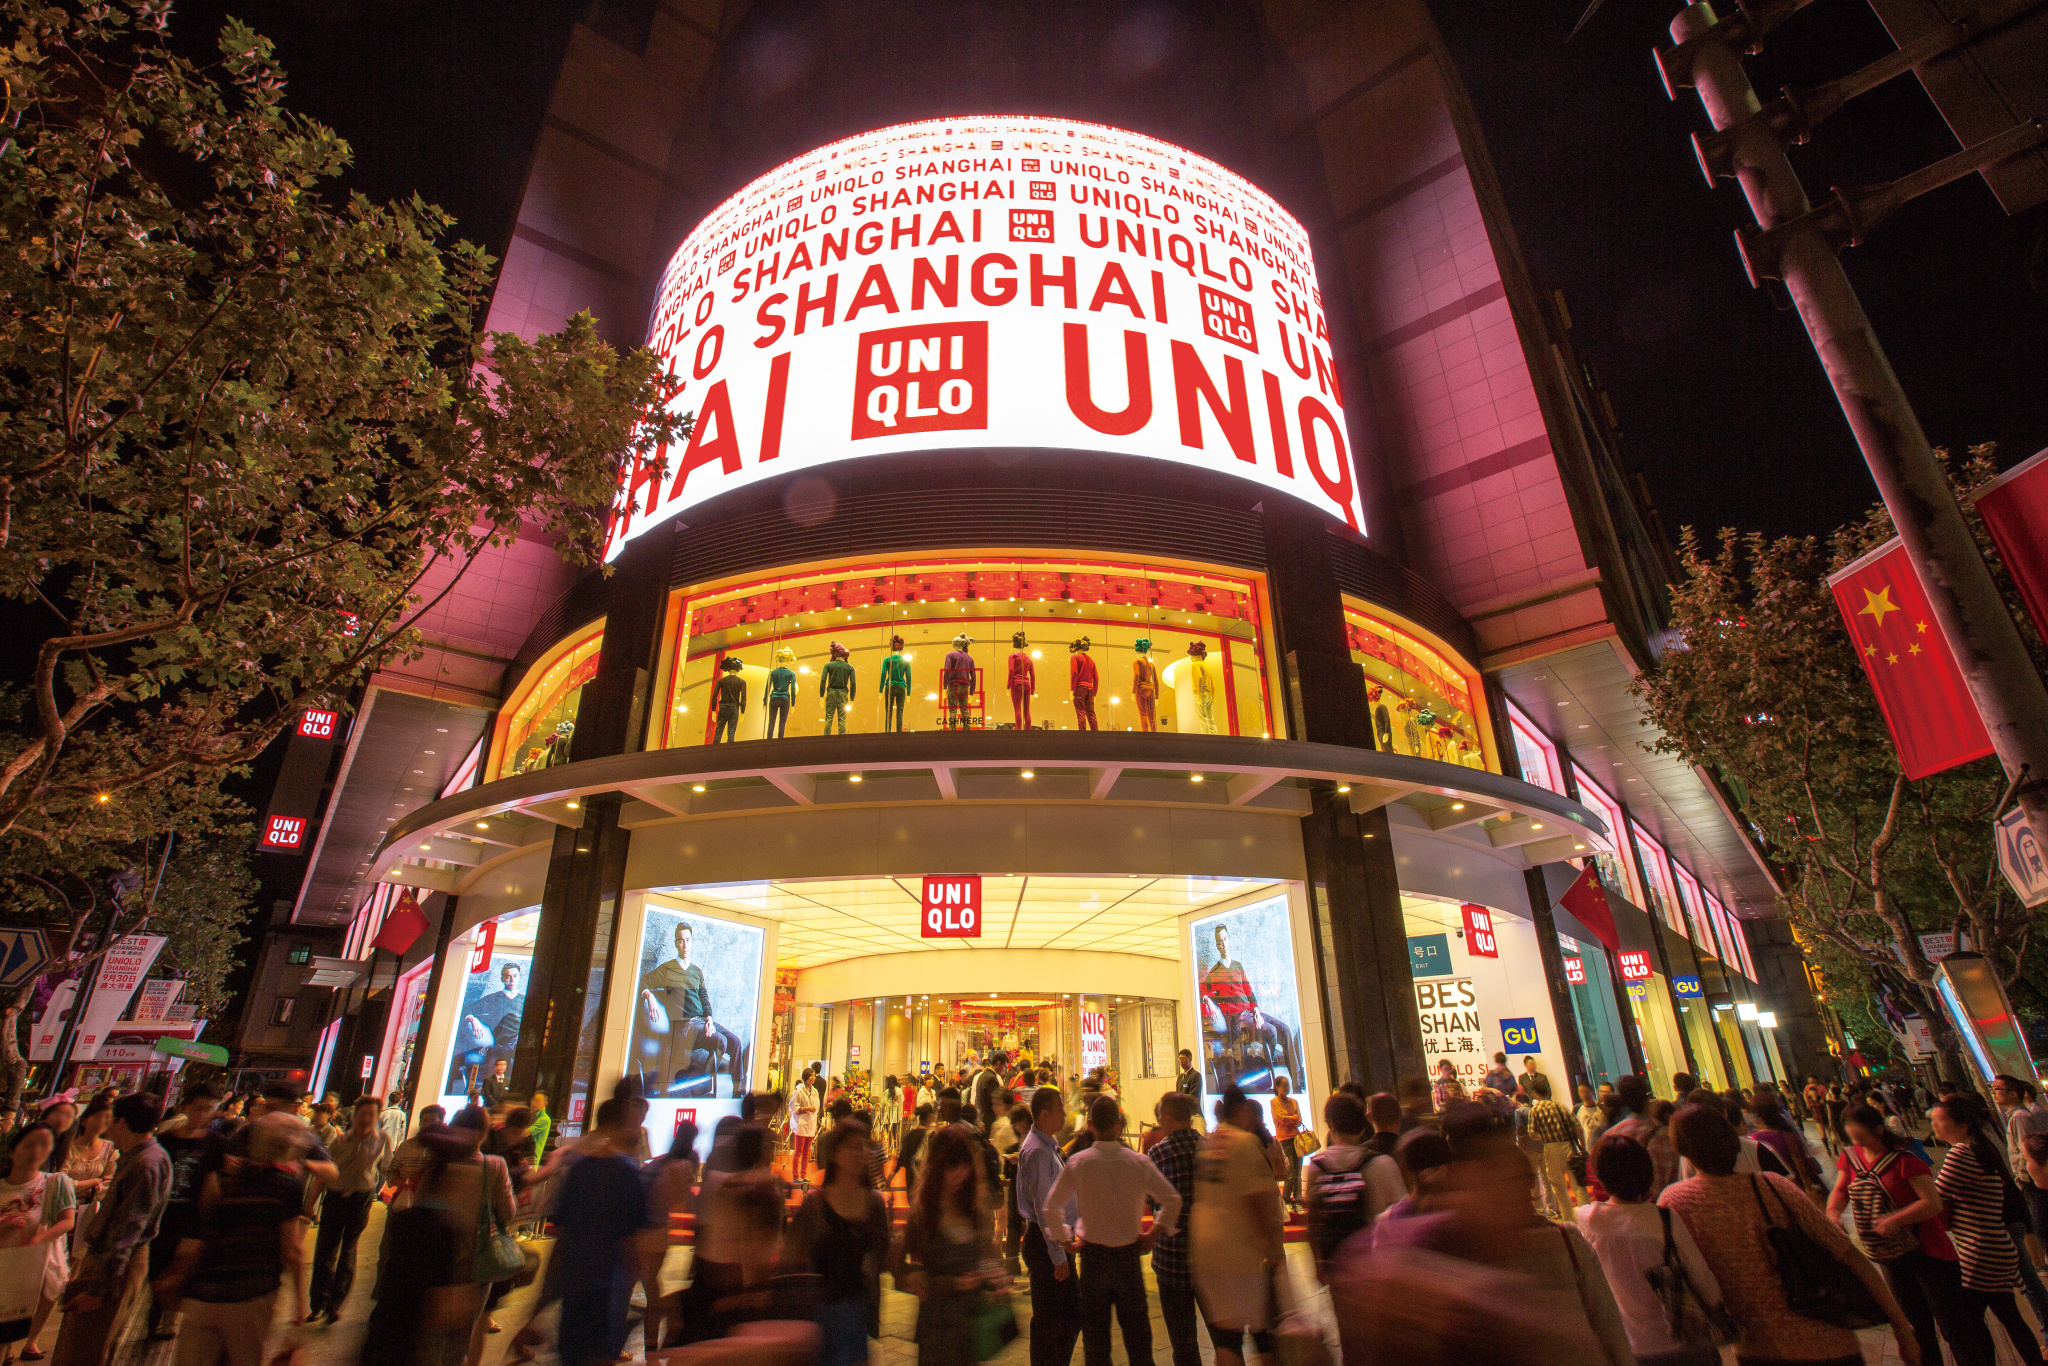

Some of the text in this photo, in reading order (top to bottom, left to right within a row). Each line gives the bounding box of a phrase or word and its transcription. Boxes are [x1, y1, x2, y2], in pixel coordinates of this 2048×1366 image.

[1032, 191, 1054, 199] QLO
[703, 205, 780, 264] SHANGHAI
[810, 170, 884, 203] UNIQLO
[895, 158, 1012, 180] SHANGHAI
[1050, 160, 1130, 184] UNIQLO
[1141, 176, 1239, 225] SHANGHAI
[1264, 228, 1311, 276] UNIQLO
[1013, 213, 1047, 225] UNI
[745, 204, 837, 260] UNIQLO
[852, 180, 1014, 216] SHANGHAI
[1070, 184, 1180, 225] UNIQLO
[1193, 214, 1308, 296] SHANGHAI
[1013, 226, 1051, 239] QLO
[731, 208, 982, 304] SHANGHAI
[1079, 213, 1254, 292] UNIQLO
[1271, 279, 1331, 342] SHA
[753, 252, 1169, 348] SHANGHAI
[1205, 290, 1245, 323] UNI
[1209, 315, 1252, 346] QLO
[870, 335, 963, 377] UNI
[866, 378, 973, 428] QLO
[1062, 322, 1360, 532] UNIQ
[306, 711, 332, 725] UNI
[936, 717, 983, 725] CASHMERE
[303, 723, 330, 736] QLO
[273, 818, 300, 832] UNI
[269, 831, 299, 844] QLO
[929, 884, 970, 904] UNI
[928, 908, 974, 932] QLO
[1471, 911, 1490, 931] UNI
[118, 938, 139, 946] EST
[476, 930, 487, 947] UNI
[1475, 932, 1495, 952] QLO
[1923, 936, 1945, 944] BEST
[108, 957, 142, 966] UNIQLO
[472, 949, 484, 970] QLO
[1620, 954, 1644, 966] UNI
[103, 974, 136, 982] 9月30日
[1624, 965, 1648, 978] QLO
[1677, 982, 1699, 992] GU
[1416, 981, 1476, 1010] BES
[1420, 1011, 1481, 1034] SHAN
[1504, 1028, 1537, 1044] GU
[1087, 1041, 1105, 1054] UNIQ
[677, 1111, 693, 1122] UNI
